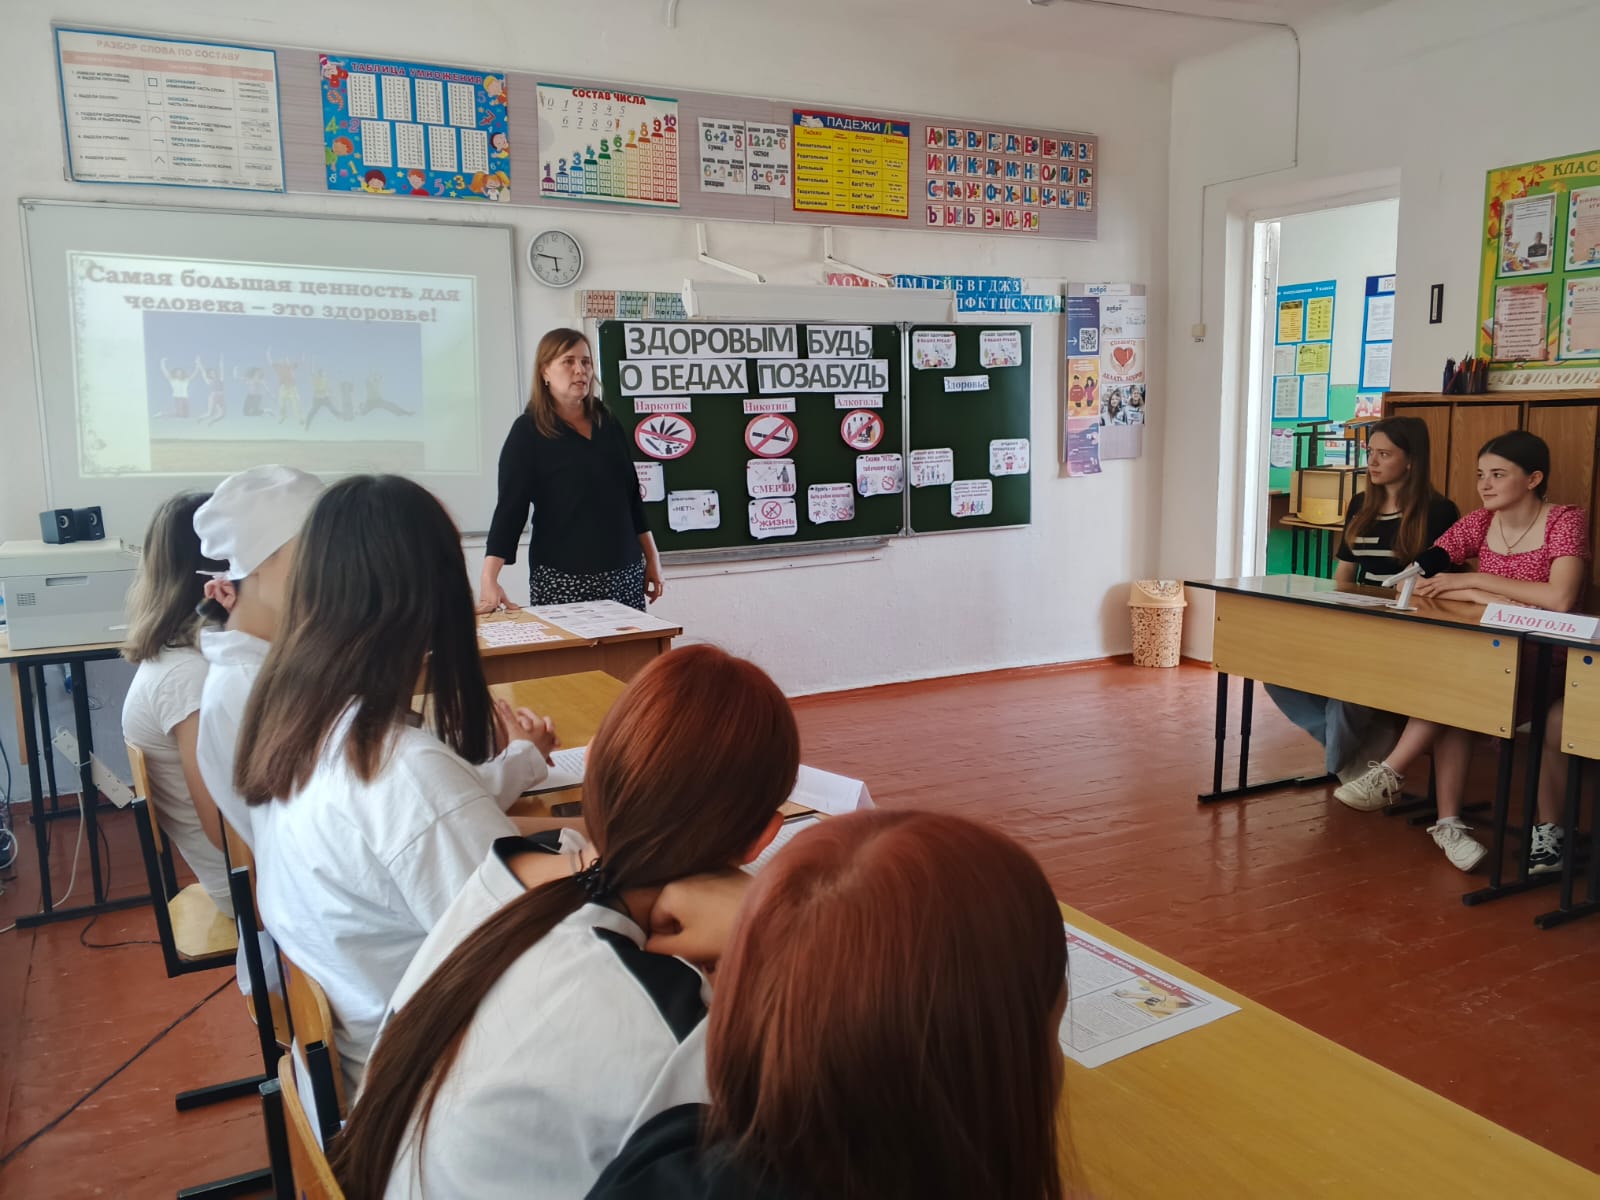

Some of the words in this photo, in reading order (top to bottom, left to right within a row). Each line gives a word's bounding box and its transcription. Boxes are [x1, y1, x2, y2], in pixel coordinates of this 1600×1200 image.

[96, 40, 137, 51] РАЗБОР
[141, 44, 176, 55] СЛОВА
[178, 47, 193, 57] ПО
[195, 49, 241, 60] СОСТАВУ
[352, 63, 406, 76] ТАБЛИЦА
[409, 68, 482, 84] УМНОЖЕНИЯ
[572, 89, 611, 101] СОСТАВ
[613, 93, 647, 106] ЧИСЛА
[653, 118, 662, 132] 9
[664, 114, 677, 127] 10
[827, 116, 881, 131] ПАДЕЖИ
[628, 130, 636, 142] 7
[640, 122, 649, 136] 8
[600, 139, 609, 153] 5
[613, 135, 623, 148] 6
[928, 128, 938, 145] А
[948, 129, 957, 146] Б
[967, 131, 977, 148] В
[988, 133, 996, 150] Г
[1006, 135, 1016, 151] Д
[1023, 137, 1033, 154] Е
[1060, 141, 1071, 157] Ж
[1079, 143, 1087, 159] З
[572, 152, 582, 165] 3
[586, 145, 595, 159] 4
[543, 163, 551, 177] 1
[558, 159, 567, 172] 2
[927, 154, 938, 171] И
[948, 154, 957, 173] Й
[967, 157, 977, 173] К
[1006, 161, 1016, 177] М
[1024, 163, 1033, 179] Н
[1042, 165, 1051, 181] О
[1079, 168, 1087, 184] Р
[928, 180, 937, 197] С
[947, 181, 956, 198] Т
[966, 183, 976, 199] У
[986, 184, 997, 201] Ф
[1005, 186, 1014, 202] Х
[1024, 186, 1032, 203] Ц
[1042, 188, 1051, 204] Ч
[928, 206, 938, 223] Ъ
[947, 207, 957, 224] Ы
[967, 208, 975, 225] Ь
[986, 209, 995, 225] Э
[1005, 210, 1015, 227] Ю
[1023, 212, 1032, 228] Я
[87, 264, 174, 287] Самая
[181, 269, 292, 294] большая
[299, 279, 413, 301] ценность
[418, 286, 460, 303] для
[123, 295, 245, 315] человека
[272, 302, 314, 319] это
[322, 304, 438, 324] здоровье!
[628, 327, 794, 356] ЗДОРОВЫМ
[620, 363, 643, 391] О
[652, 363, 745, 394] БЕДАХ
[758, 363, 887, 389] ПОЗАБУДЬ
[946, 380, 988, 391] Здоровье
[635, 402, 689, 413] Наркотик
[744, 401, 789, 413] Никотин
[836, 398, 880, 408] Алкоголь
[752, 483, 795, 494] СМЕРТИ
[759, 518, 795, 528] ЖИЗНЬ
[1490, 608, 1577, 633] Алкоголь
